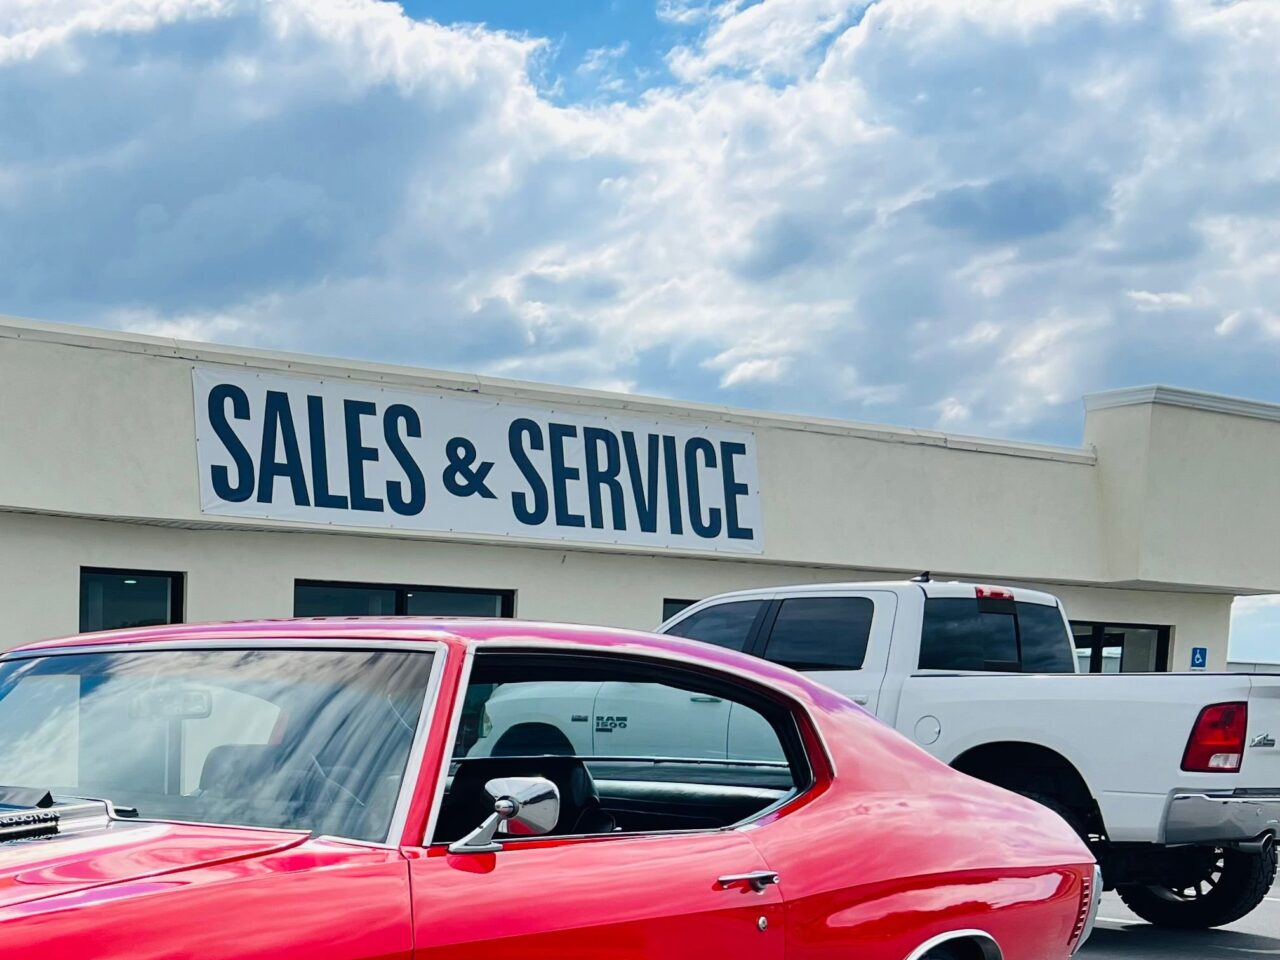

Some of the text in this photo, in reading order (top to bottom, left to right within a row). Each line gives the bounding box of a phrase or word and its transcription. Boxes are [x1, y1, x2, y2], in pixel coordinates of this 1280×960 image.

[207, 383, 754, 540] SALES & SERVICE
